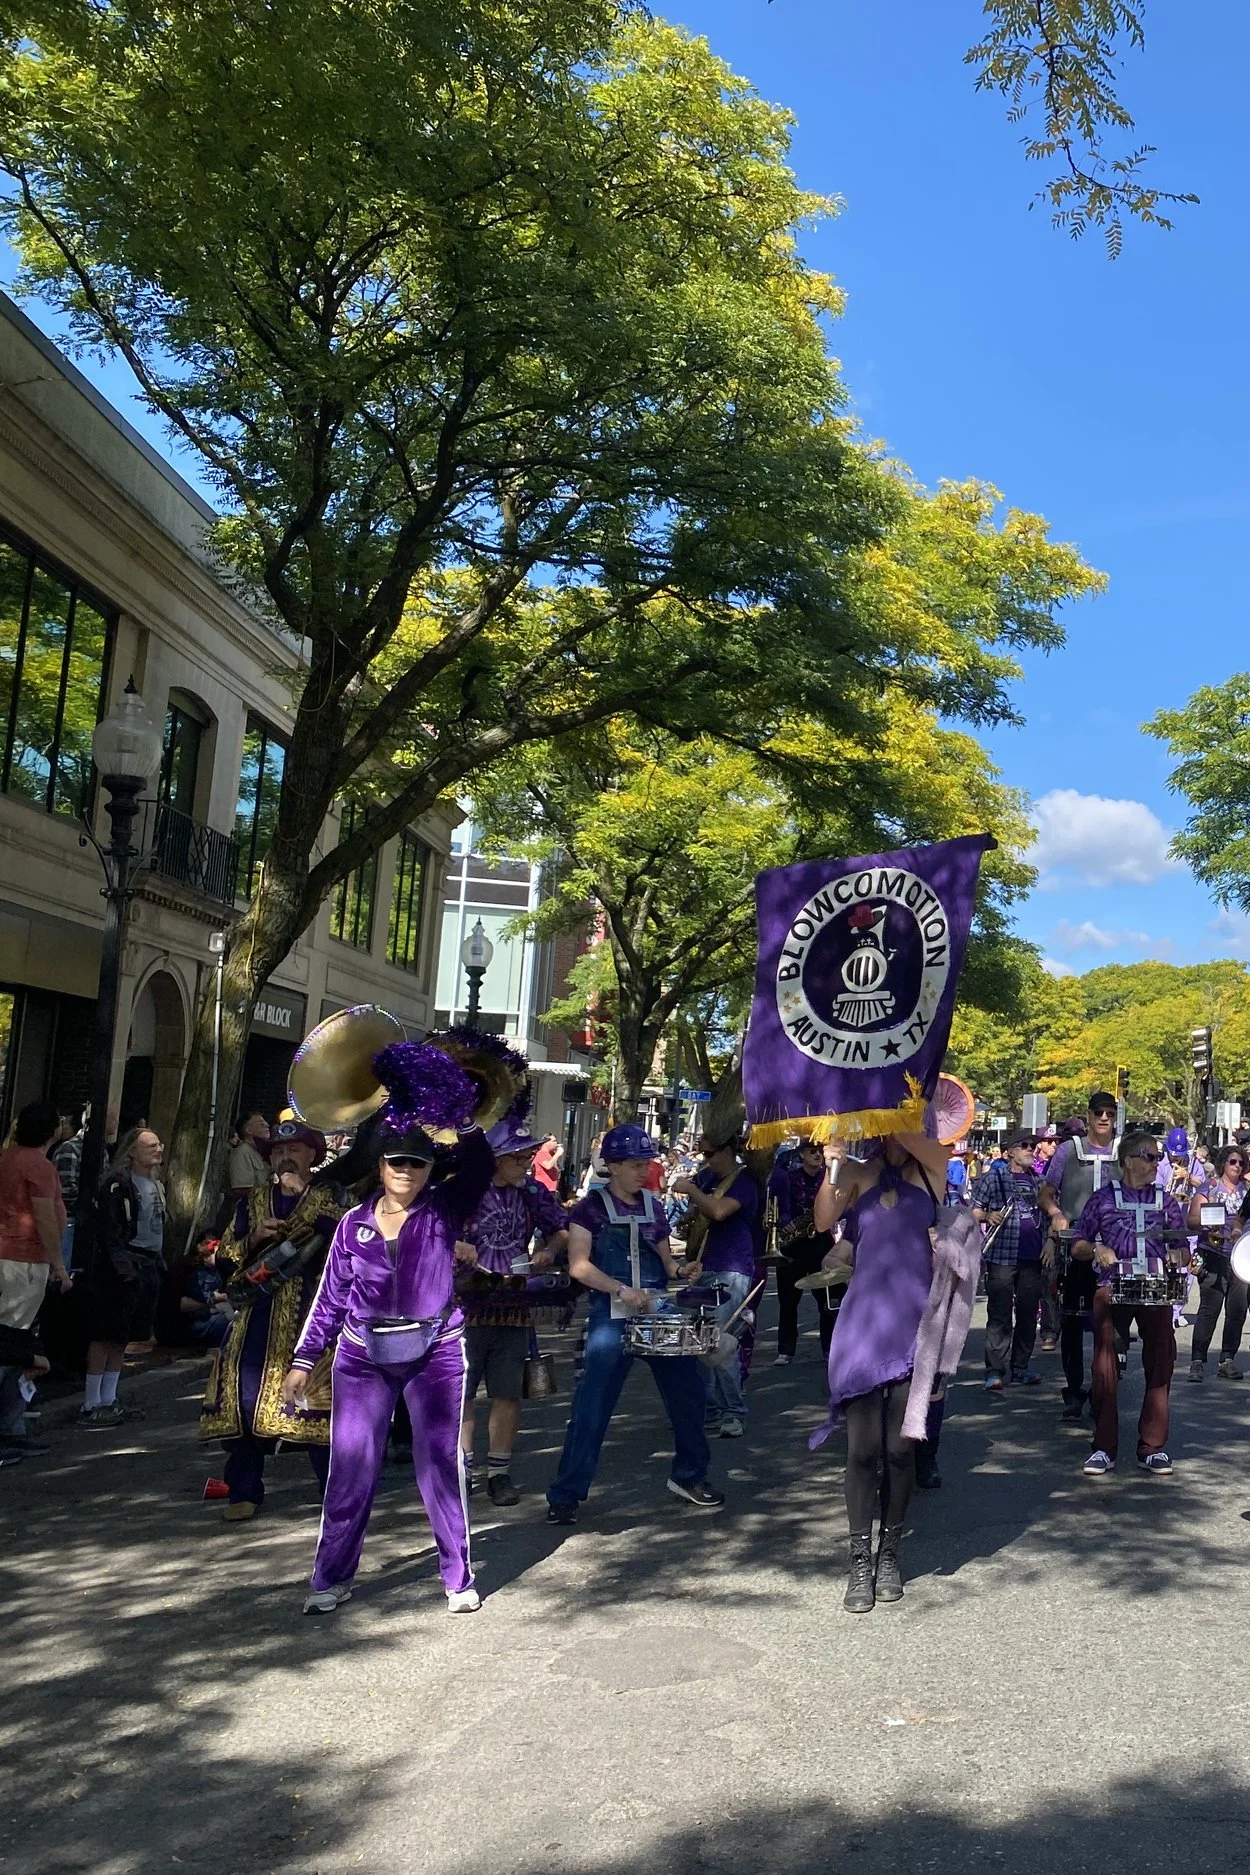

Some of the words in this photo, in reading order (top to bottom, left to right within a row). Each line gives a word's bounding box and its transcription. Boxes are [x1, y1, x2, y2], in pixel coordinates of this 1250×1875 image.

[778, 870, 945, 982] BLOWCOMOTION
[266, 1004, 292, 1028] BLOCK
[787, 1015, 870, 1062] AUSTIN
[902, 1011, 929, 1045] TX
